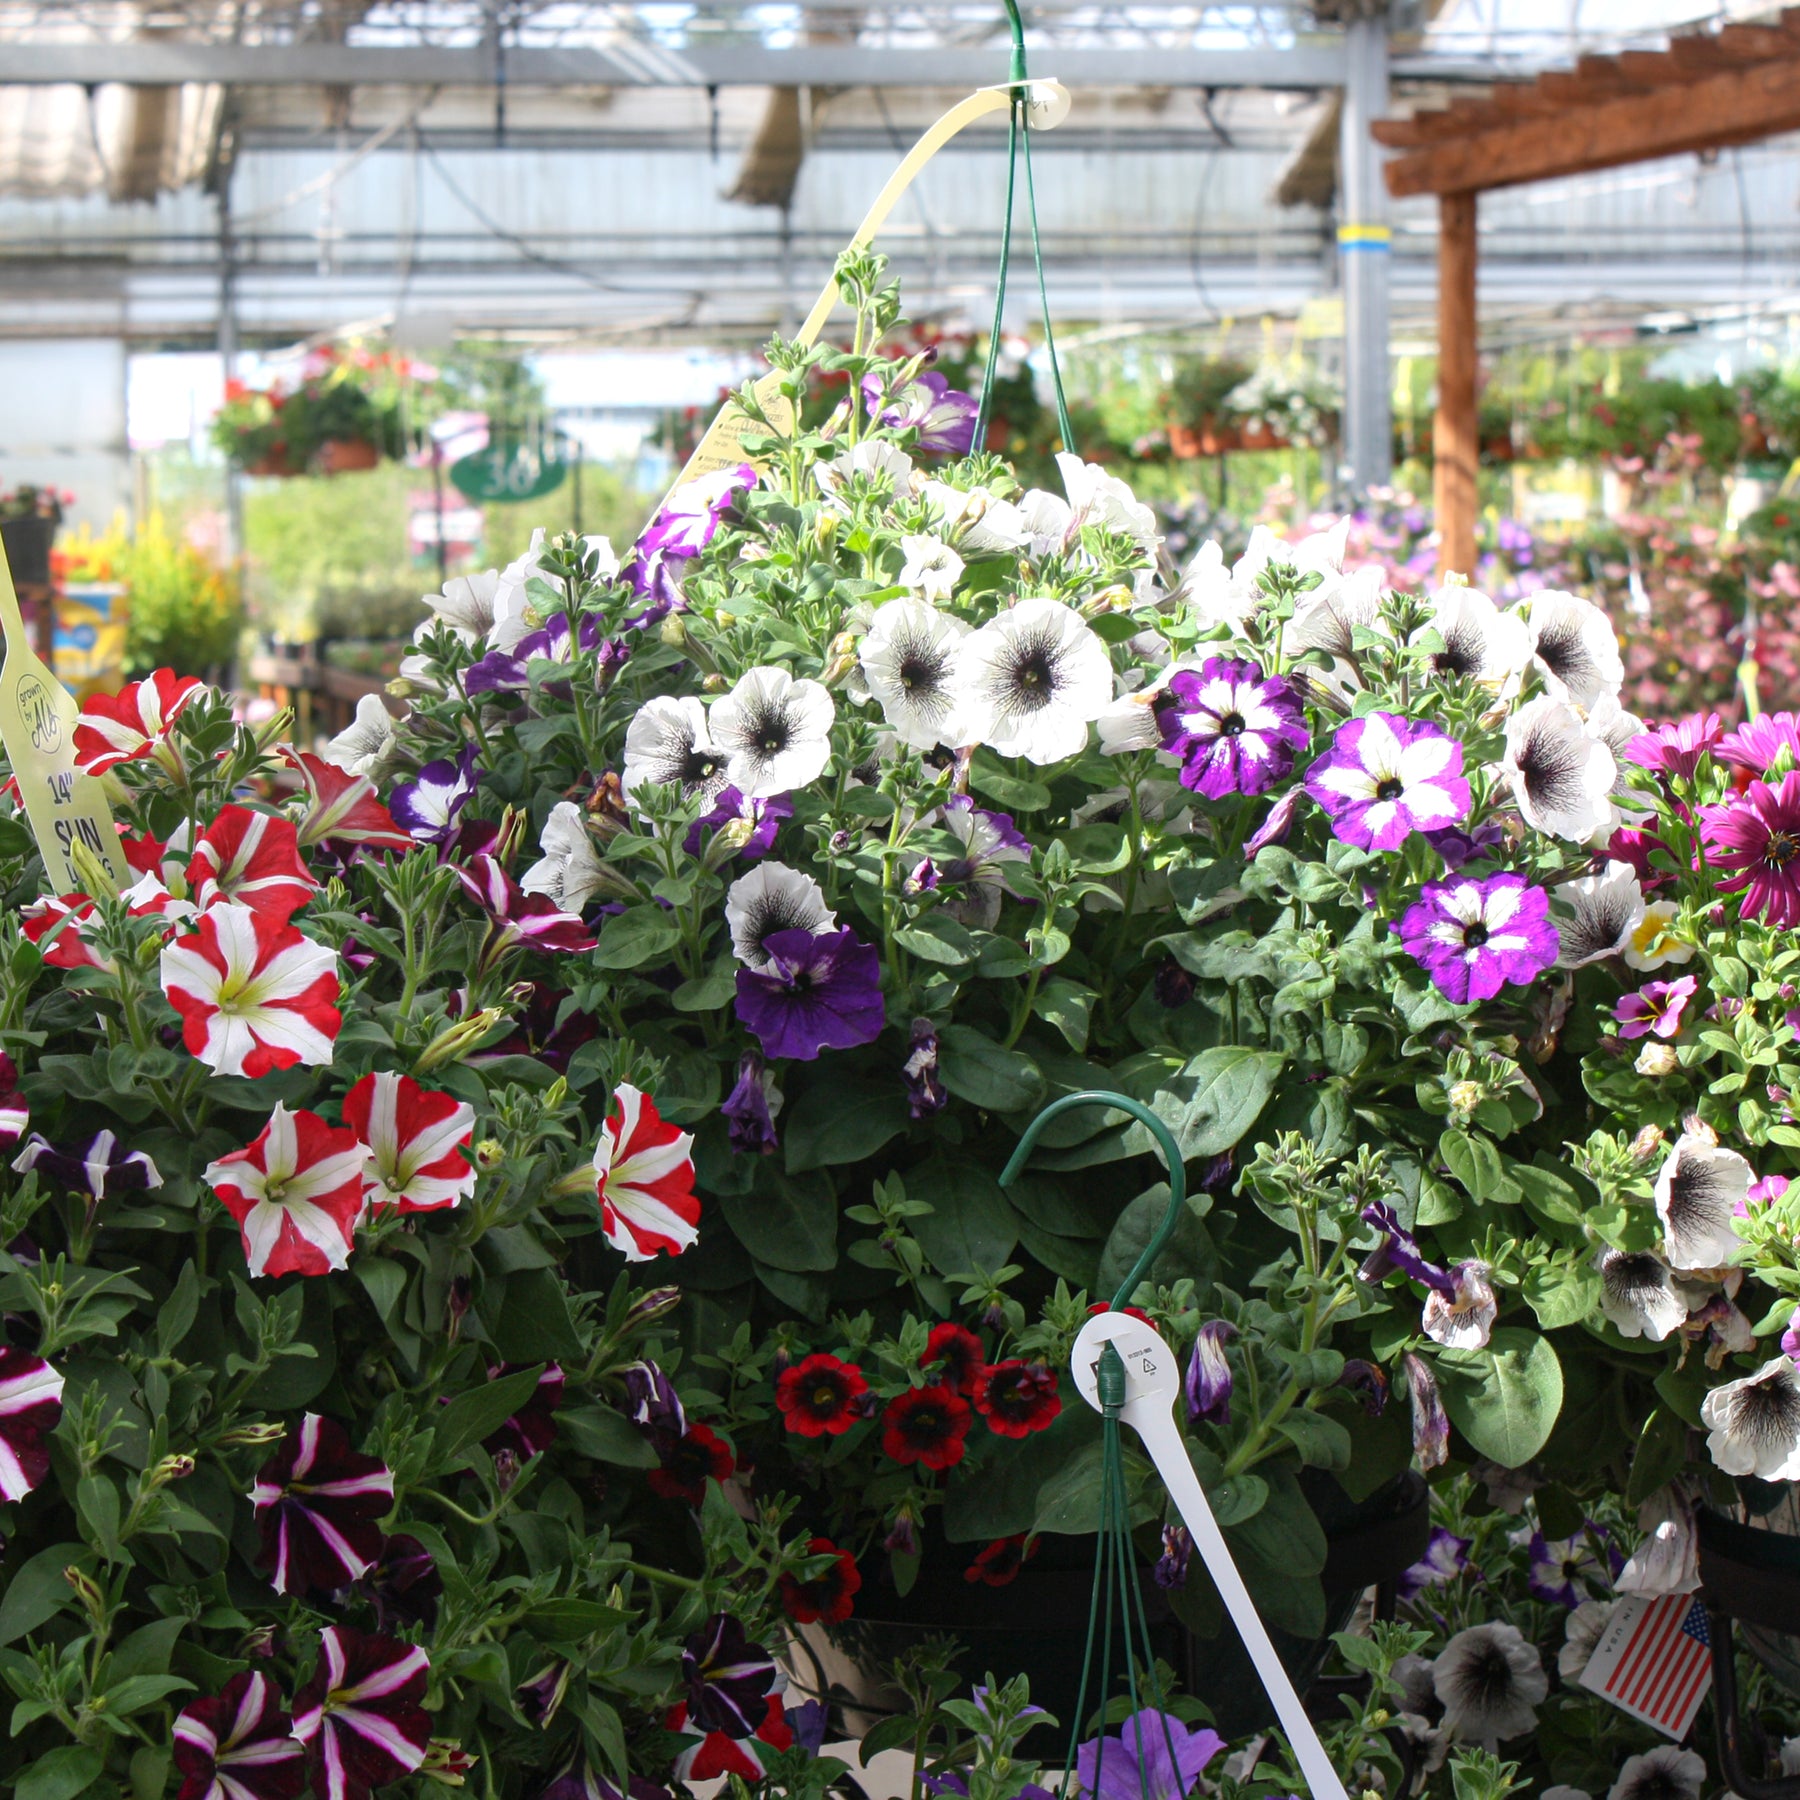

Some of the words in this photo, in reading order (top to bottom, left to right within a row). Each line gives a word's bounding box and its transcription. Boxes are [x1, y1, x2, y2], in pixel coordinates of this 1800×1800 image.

[19, 683, 42, 707] grown
[24, 711, 33, 723] by
[48, 772, 73, 804] 14"
[55, 817, 103, 857] SUN
[1604, 1627, 1622, 1653] USA
